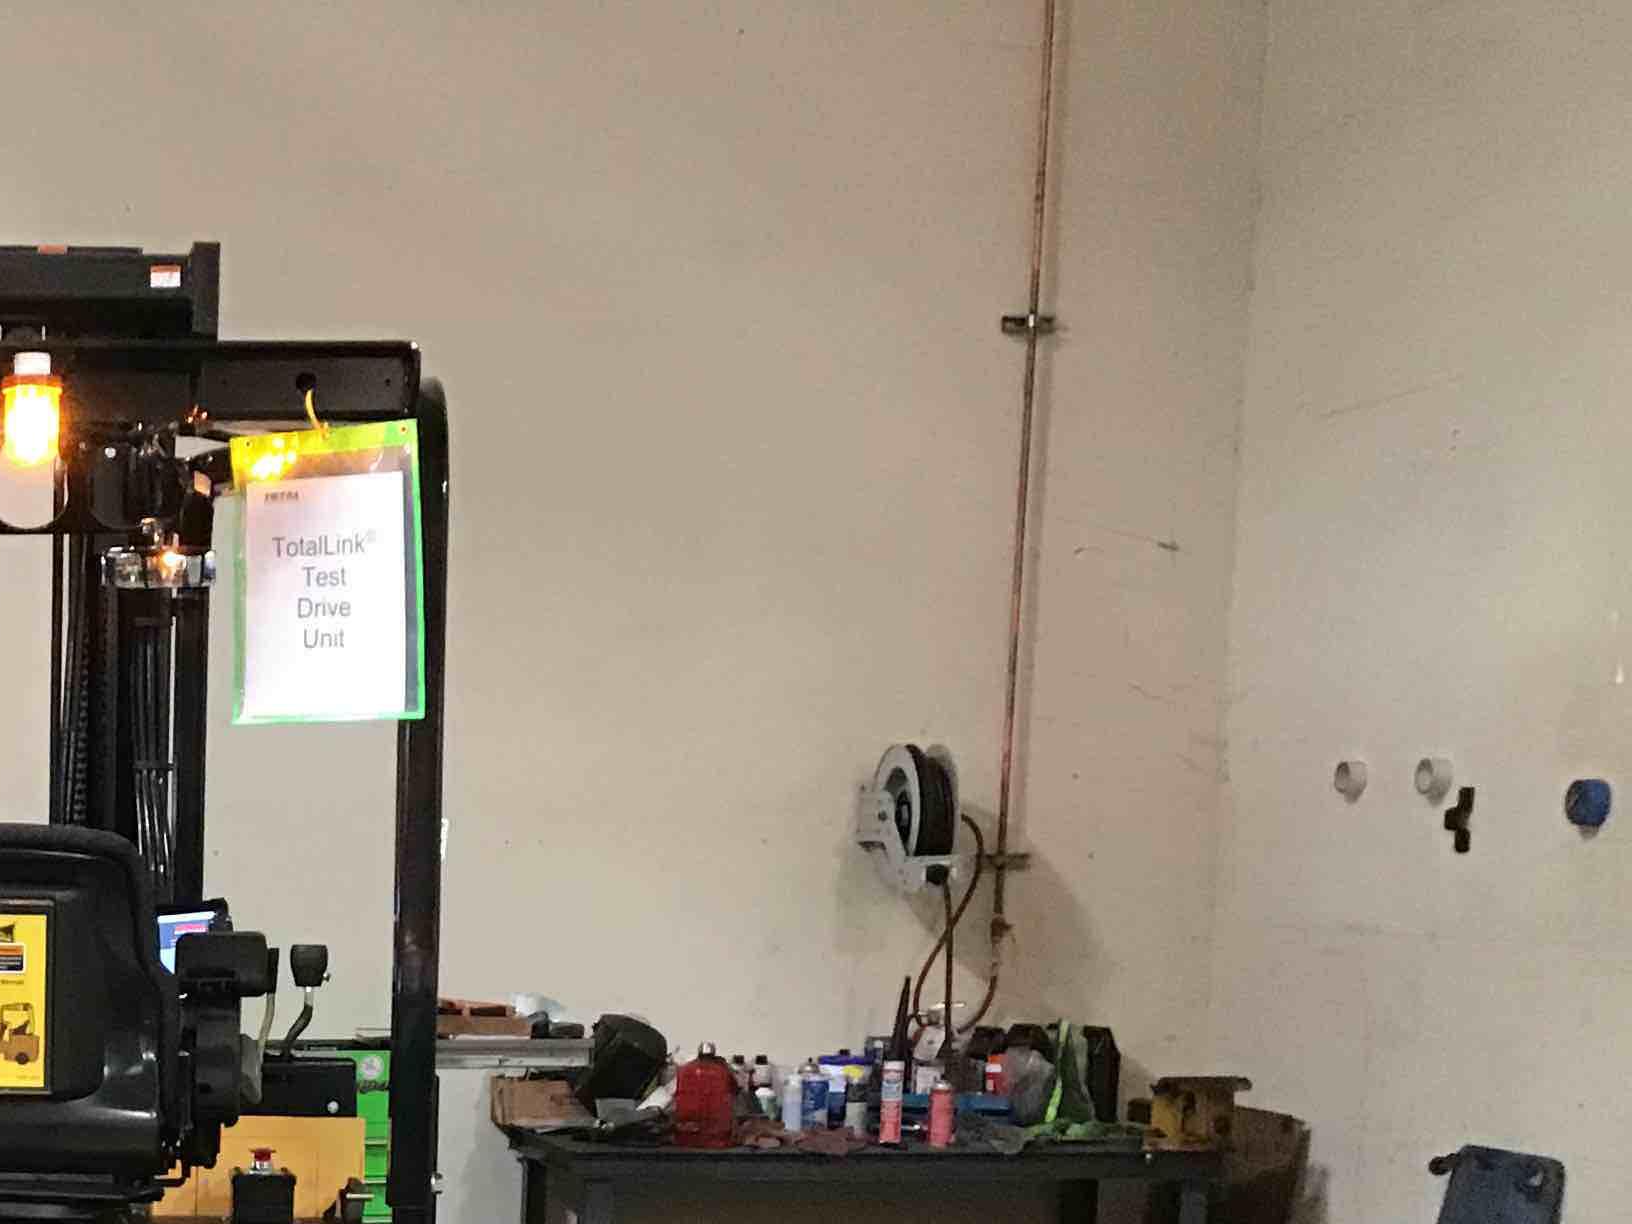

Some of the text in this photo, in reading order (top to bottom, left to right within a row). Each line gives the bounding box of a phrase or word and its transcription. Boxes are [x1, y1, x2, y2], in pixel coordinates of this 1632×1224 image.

[302, 565, 347, 588] Test
[297, 596, 351, 619] Drive
[303, 628, 345, 649] Unit
